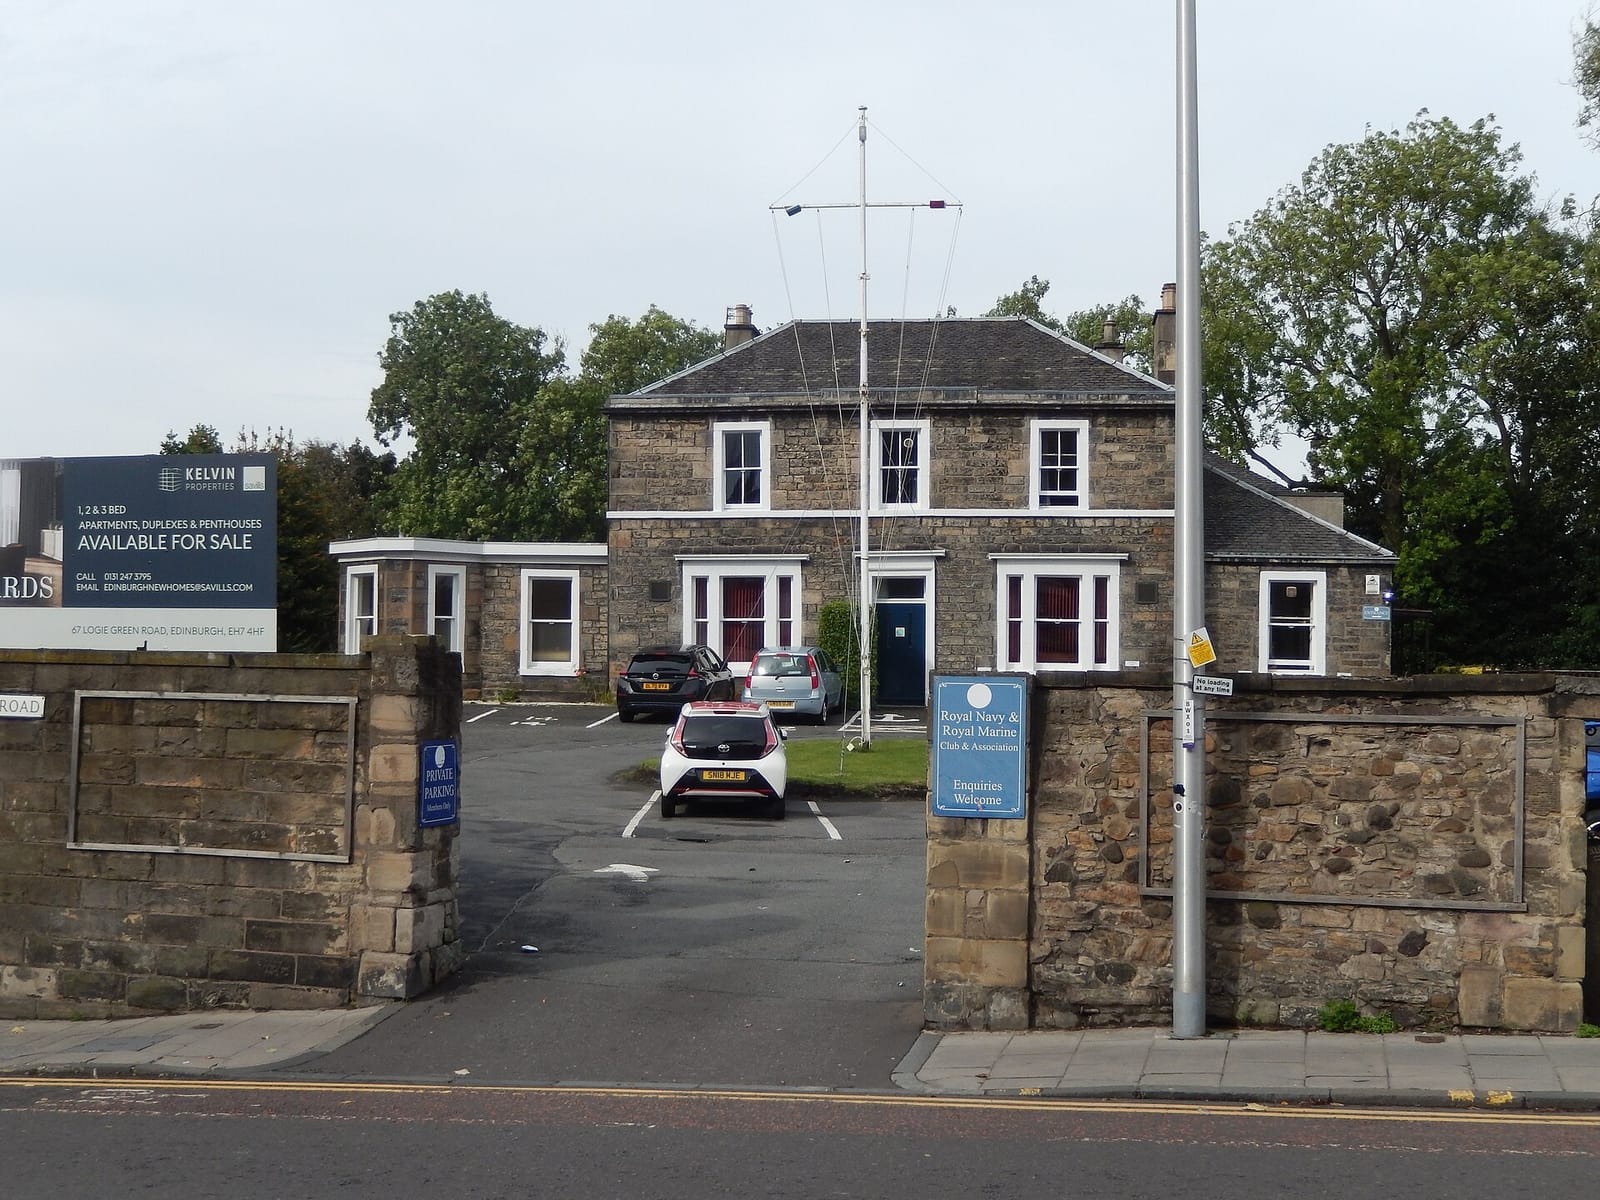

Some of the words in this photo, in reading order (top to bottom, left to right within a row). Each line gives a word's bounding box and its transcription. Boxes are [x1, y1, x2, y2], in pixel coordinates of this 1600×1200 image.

[186, 468, 234, 480] KELVIN
[186, 482, 234, 490] PROPERTIES
[85, 506, 91, 514] 2
[92, 506, 100, 514] &
[101, 506, 107, 514] 3
[108, 506, 126, 514] BED
[78, 520, 140, 530] APARTMENTS,
[142, 520, 188, 529] DUPLEXES
[190, 520, 198, 529] &
[200, 520, 262, 529] PENTHOUSES
[78, 534, 167, 550] AVAILABLE
[172, 534, 206, 550] FOR
[210, 534, 252, 550] SALE
[76, 573, 96, 581] CALL
[104, 572, 118, 581] 0131
[120, 572, 134, 581] 247
[134, 572, 152, 581] 3795
[0, 576, 54, 599] RDS
[76, 584, 100, 592] EMAIL
[104, 584, 253, 592] EDINBURGHNEWHOMES@SAVILLS.COM
[72, 626, 81, 634] 67
[83, 626, 108, 634] LOGIE
[110, 626, 140, 634] GREEN
[141, 626, 168, 636] ROAD,
[170, 626, 226, 636] EDINBURGH,
[228, 627, 245, 636] EH7
[246, 627, 264, 636] 4HF
[1208, 679, 1230, 687] loading
[0, 700, 40, 713] ROAD
[941, 710, 972, 723] Royal
[976, 711, 1005, 724] Navy
[1009, 712, 1019, 722] &
[943, 726, 974, 738] Royal
[978, 726, 1017, 737] Marine
[940, 741, 960, 750] Club
[971, 742, 1018, 752] Association
[426, 768, 453, 782] PRIVATE
[424, 785, 454, 799] PARKING
[954, 780, 1002, 793] Enquiries
[954, 794, 1002, 805] Welcome
